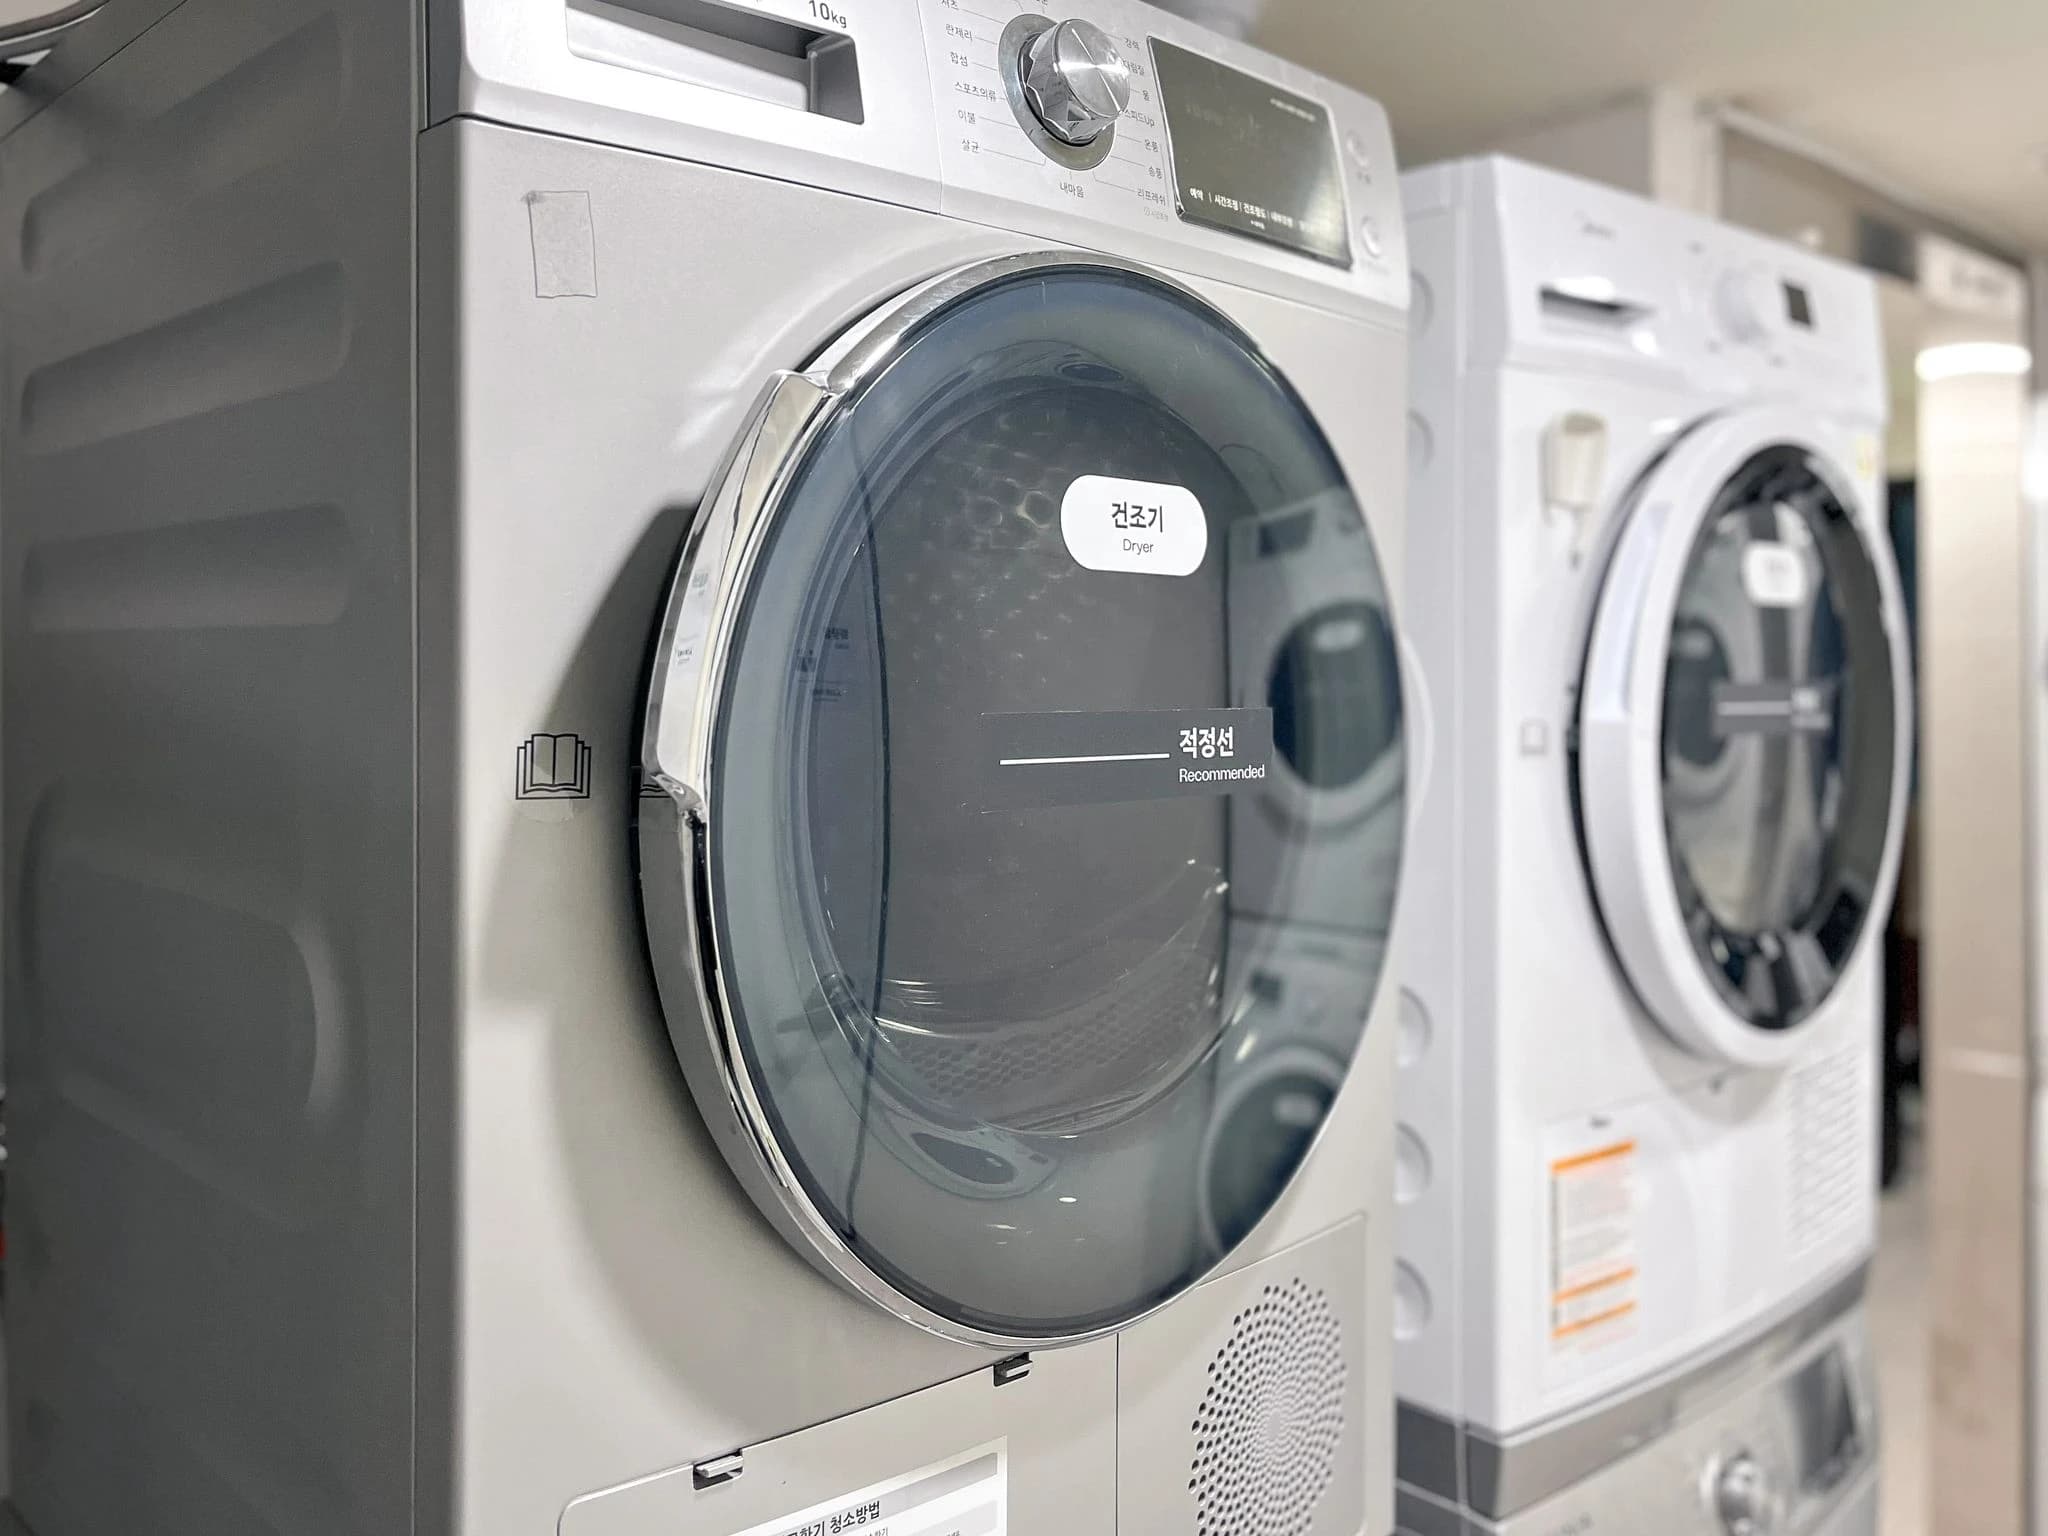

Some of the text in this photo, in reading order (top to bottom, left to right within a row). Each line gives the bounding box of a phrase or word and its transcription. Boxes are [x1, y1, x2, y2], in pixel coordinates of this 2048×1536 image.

[809, 0, 847, 28] 10kg
[946, 24, 973, 41] 란제리
[954, 81, 997, 101] 스포츠의류
[1059, 181, 1084, 198] 내마음
[1111, 501, 1164, 533] 건조기
[1122, 538, 1154, 556] Dryer
[1179, 726, 1234, 759] 적정선
[1178, 764, 1265, 783] Recommended
[830, 1500, 880, 1534] 청소방법
